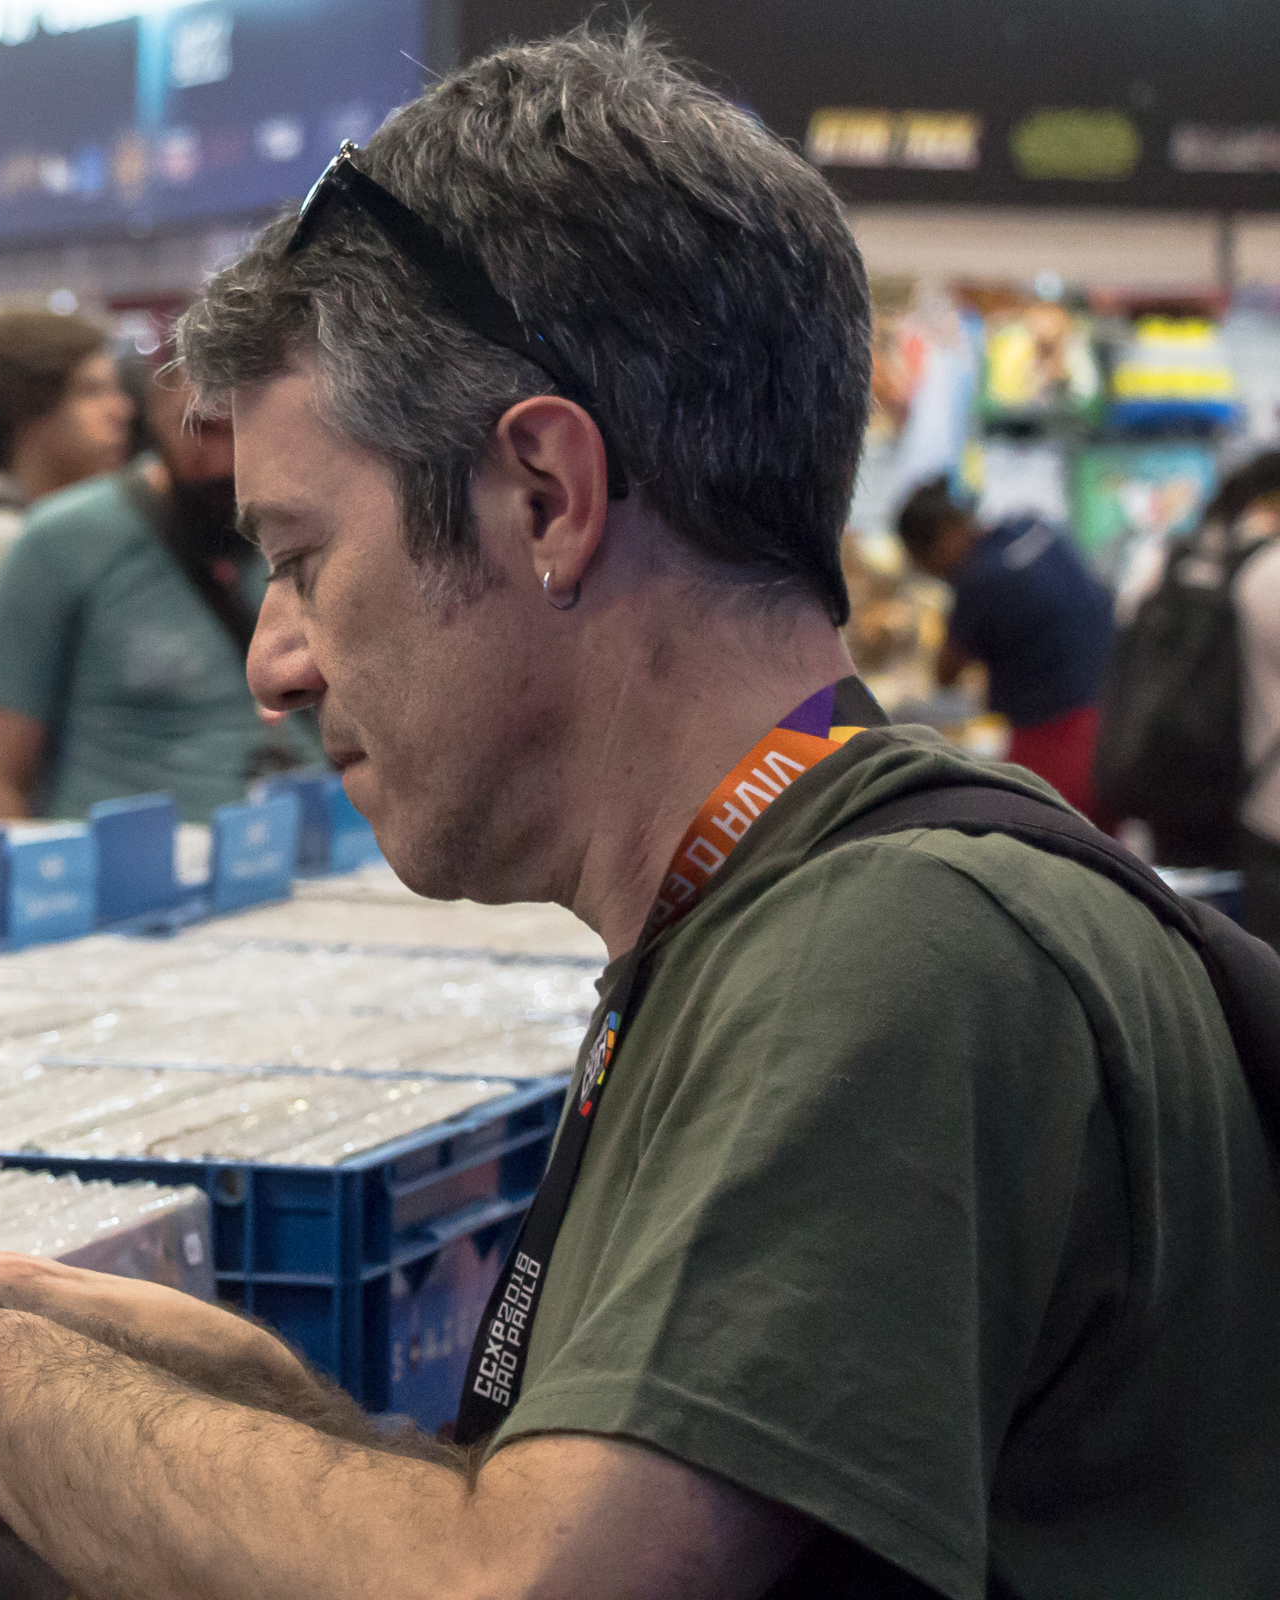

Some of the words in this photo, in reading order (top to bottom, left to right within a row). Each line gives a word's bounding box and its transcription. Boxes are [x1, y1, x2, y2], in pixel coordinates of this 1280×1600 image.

[710, 750, 806, 842] VIVA
[685, 836, 727, 874] O
[473, 1251, 530, 1399] CCXP2018
[507, 1258, 541, 1348] PAULO
